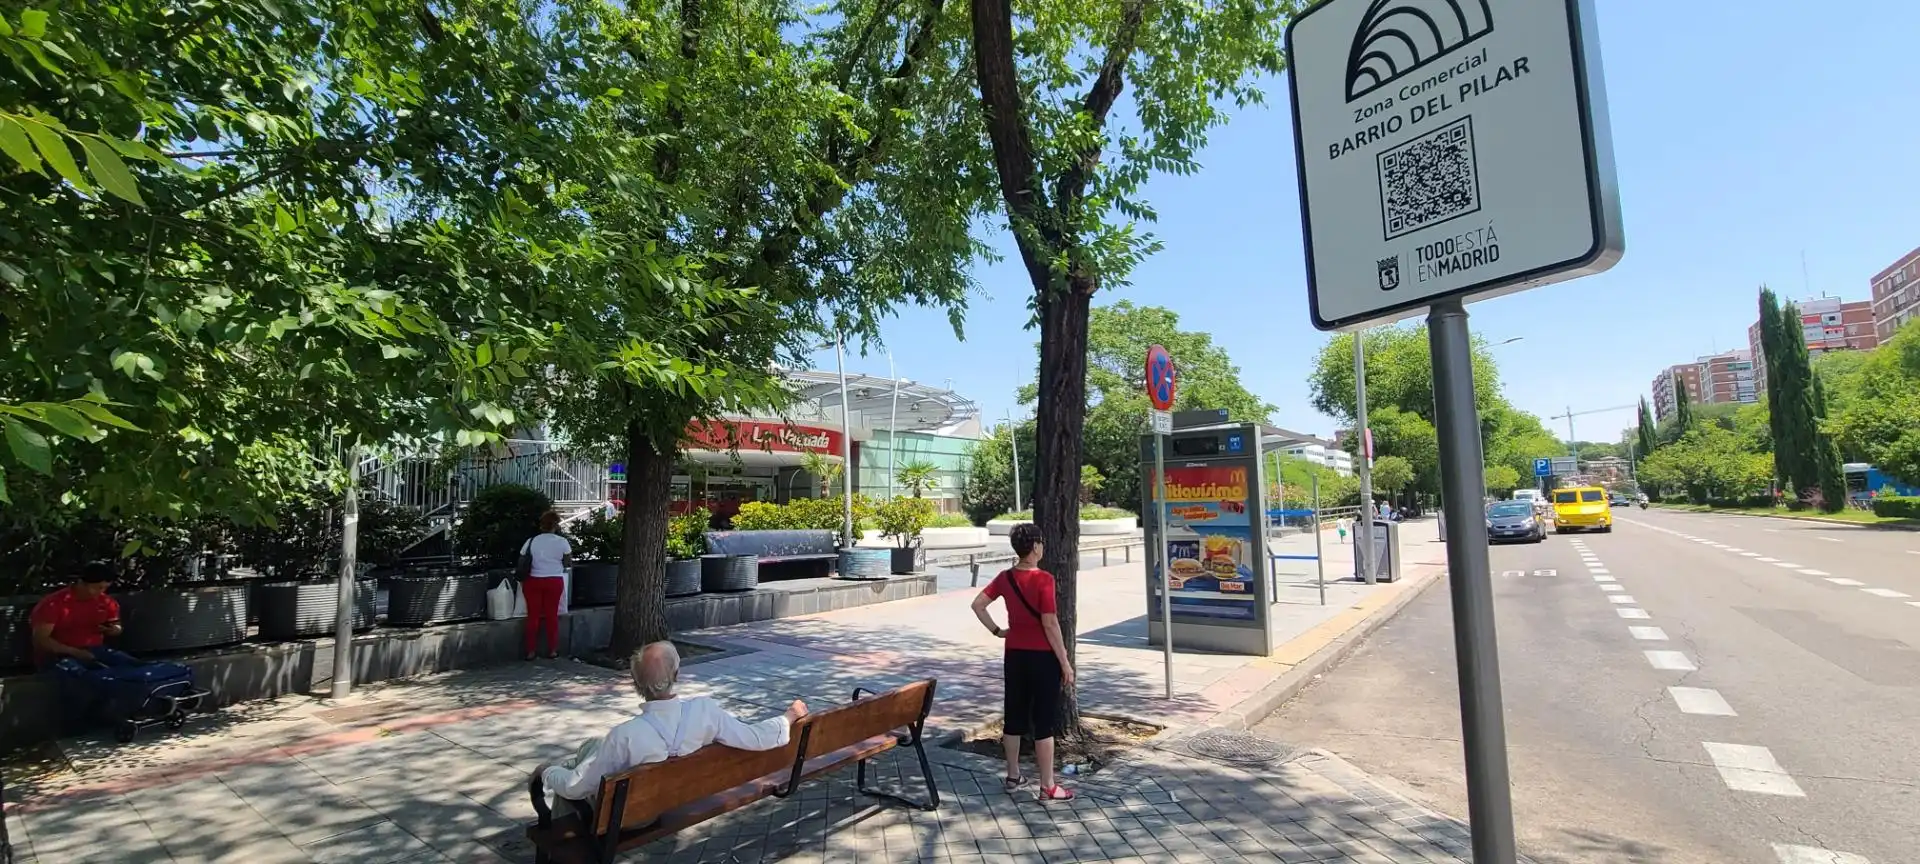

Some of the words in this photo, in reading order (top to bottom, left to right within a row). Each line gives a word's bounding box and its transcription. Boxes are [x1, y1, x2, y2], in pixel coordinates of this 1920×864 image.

[1328, 115, 1403, 160] BARRIO
[1410, 94, 1453, 125] DEL
[1458, 56, 1531, 103] PILAR
[1354, 97, 1394, 124] Zona
[1398, 47, 1488, 102] Comercial
[1418, 243, 1500, 283] ENMADRID
[1536, 459, 1547, 469] P
